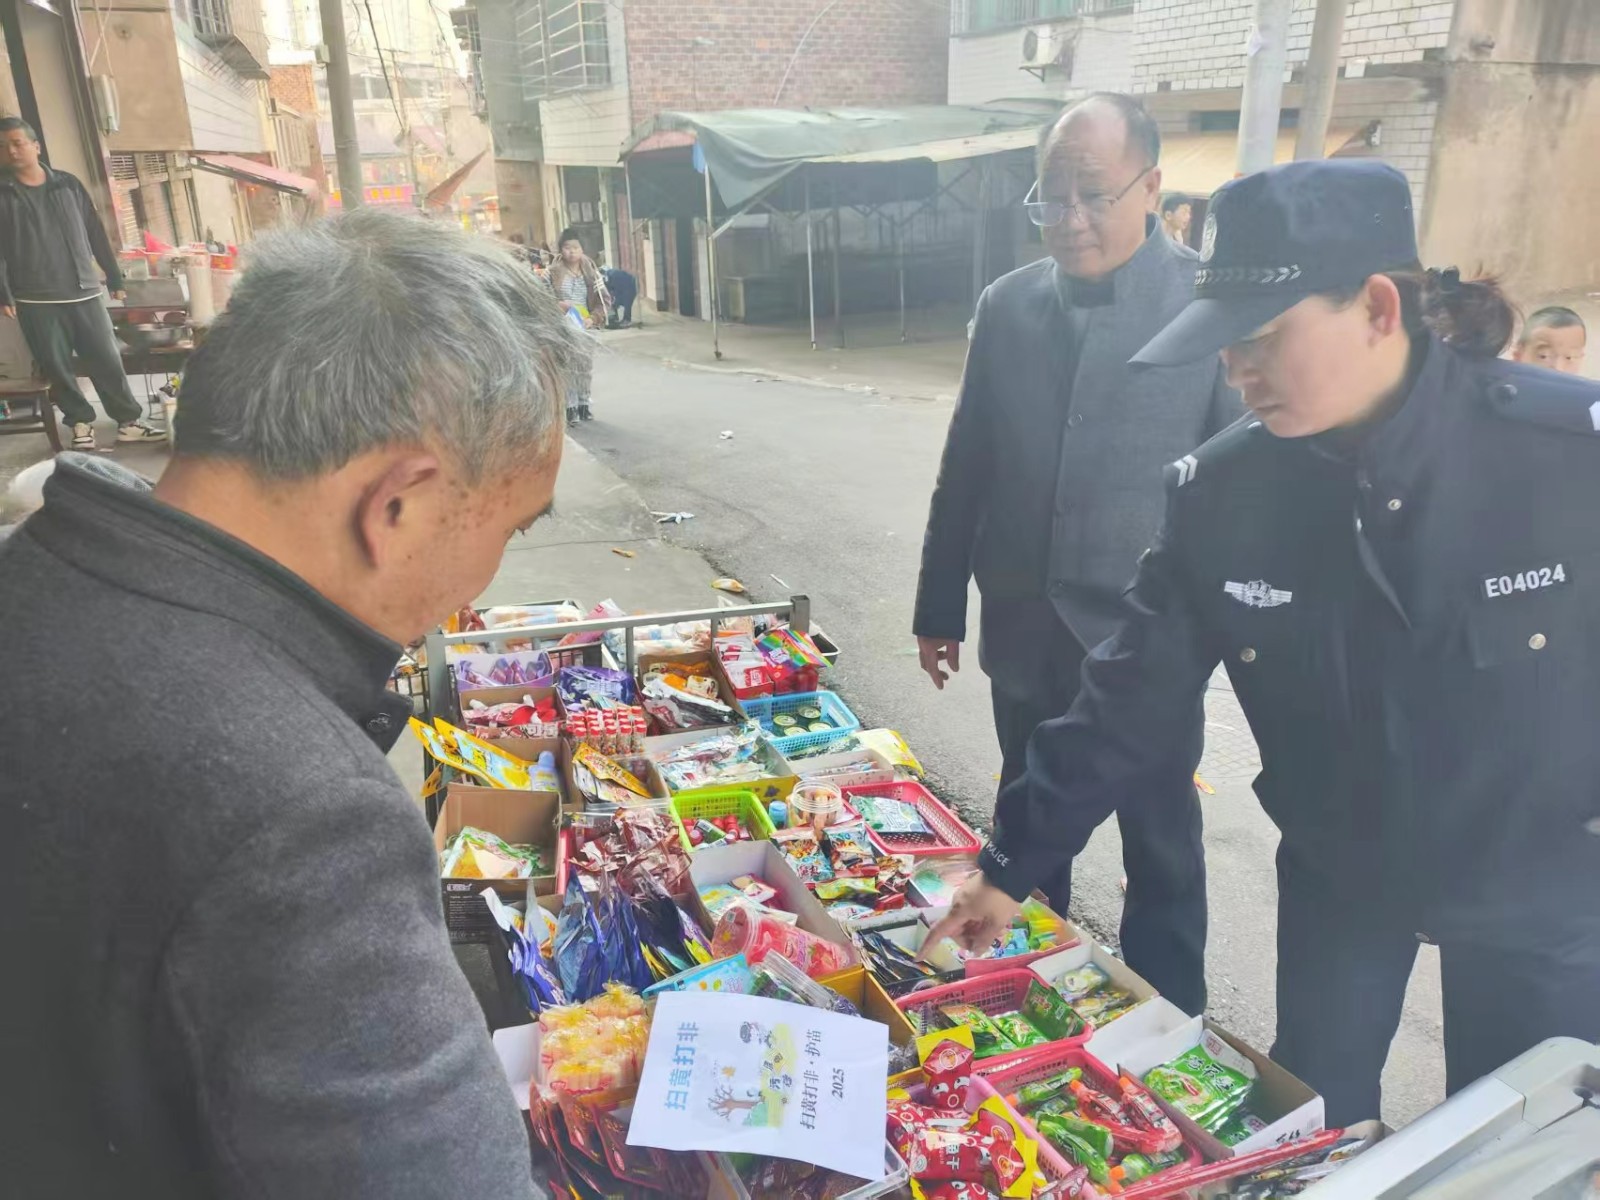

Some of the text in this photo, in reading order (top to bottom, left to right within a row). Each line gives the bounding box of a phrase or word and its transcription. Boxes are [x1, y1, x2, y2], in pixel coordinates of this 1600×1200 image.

[1484, 563, 1567, 599] E04024
[664, 1021, 700, 1111] 扫黄打非
[831, 1067, 845, 1100] 2025
